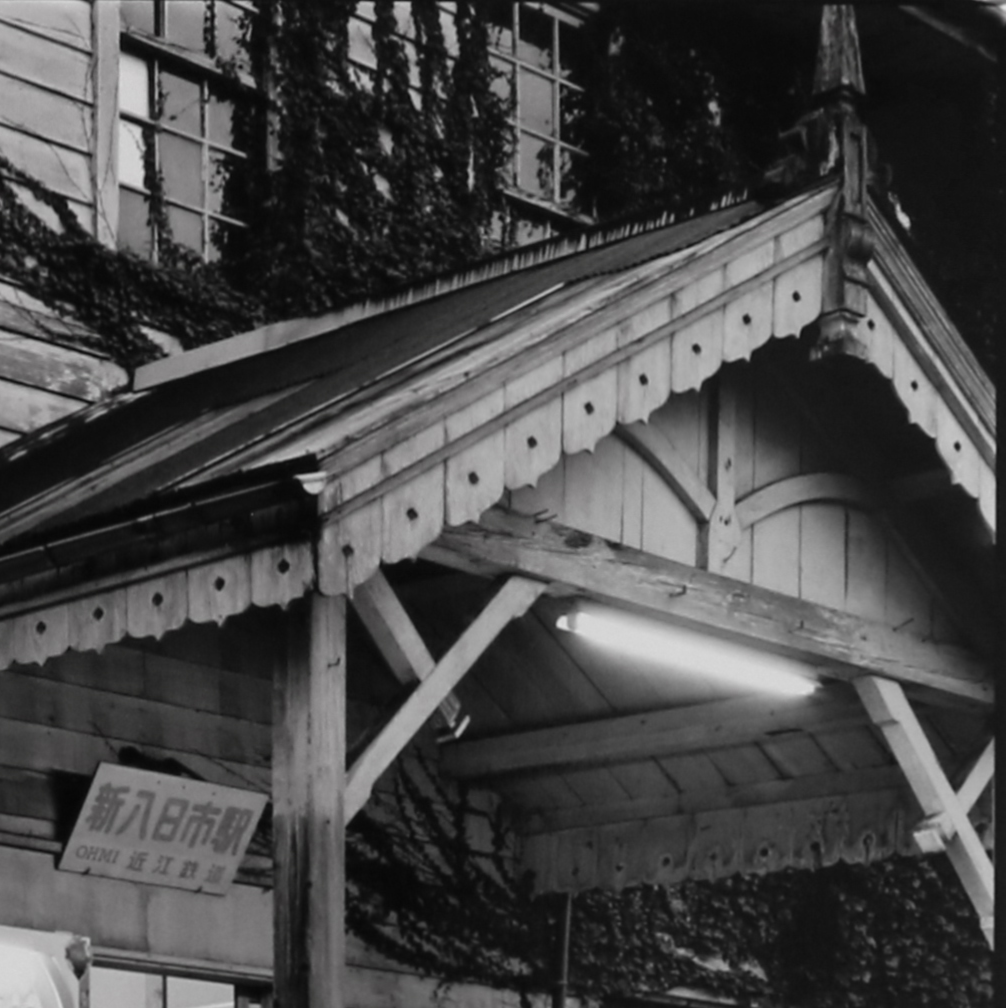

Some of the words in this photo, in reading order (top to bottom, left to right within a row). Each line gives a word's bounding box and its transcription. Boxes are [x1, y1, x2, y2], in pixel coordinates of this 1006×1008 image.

[85, 780, 255, 857] 新八日市駅
[75, 845, 120, 865] OHMI
